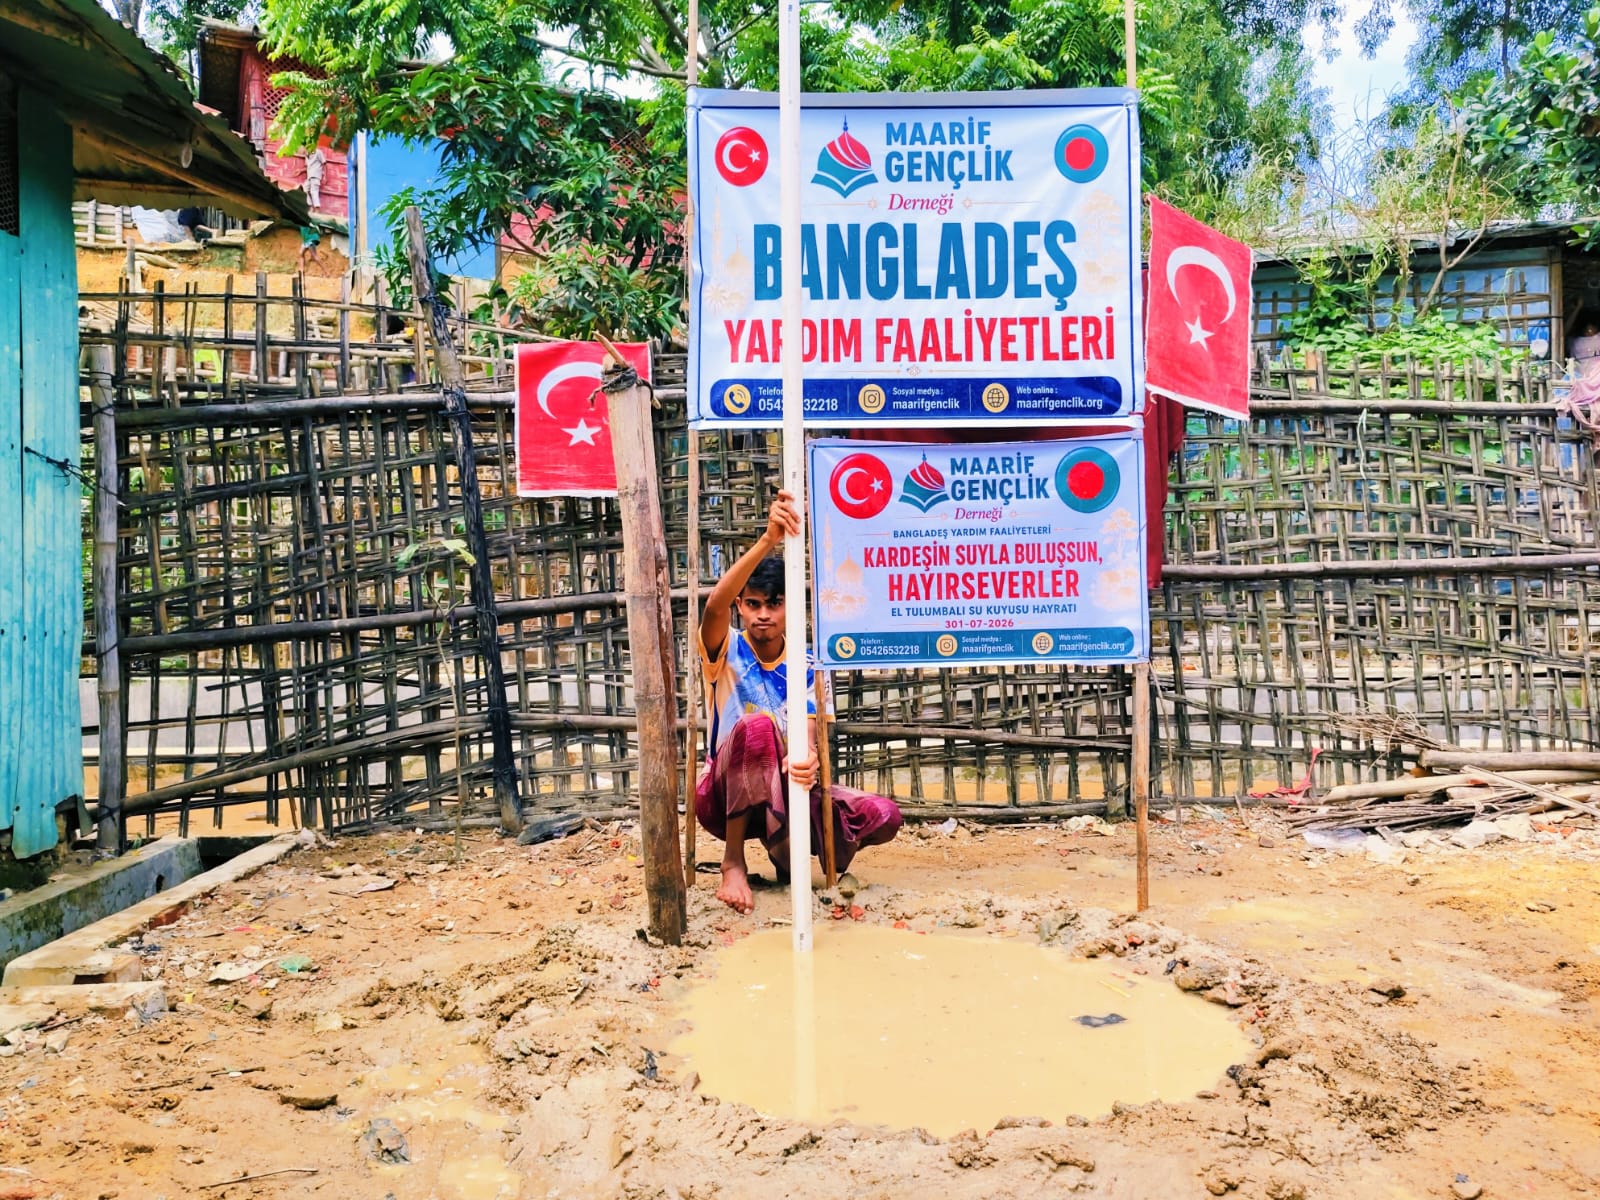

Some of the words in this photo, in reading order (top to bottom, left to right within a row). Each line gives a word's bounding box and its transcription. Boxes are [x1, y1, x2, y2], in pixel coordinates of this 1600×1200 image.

[886, 116, 991, 145] MAARİF
[885, 145, 1013, 189] GENÇLİK
[888, 193, 954, 215] Derneği
[876, 307, 1114, 362] FAALİYETLERİ
[758, 386, 784, 396] Telefo
[759, 397, 838, 411] 05432218
[892, 397, 960, 411] maarifgenclik
[1016, 396, 1103, 410] maarifgenclik.org
[950, 452, 1034, 476] MAARİF
[951, 474, 1050, 505] GENÇLİK
[955, 508, 1002, 522] Derneği
[893, 528, 948, 539] BANGLADEŞ
[951, 528, 987, 537] YARDIM
[990, 524, 1051, 536] FAALİYETLERİ
[864, 541, 950, 572] KARDEŞİN
[956, 544, 1009, 566] SUYLA
[1015, 541, 1103, 570] BULUŞSUN,
[888, 570, 1079, 601] HAYIRSEVERLER
[892, 607, 903, 617] EL
[905, 606, 965, 616] TULUMBALI
[968, 605, 983, 615] SU
[986, 605, 1030, 615] KUYUSU
[1033, 604, 1077, 614] HAYRATI
[945, 618, 1014, 629] 301-07-2026
[860, 645, 920, 656] 05426532218
[962, 644, 1014, 654] maarifgenclik
